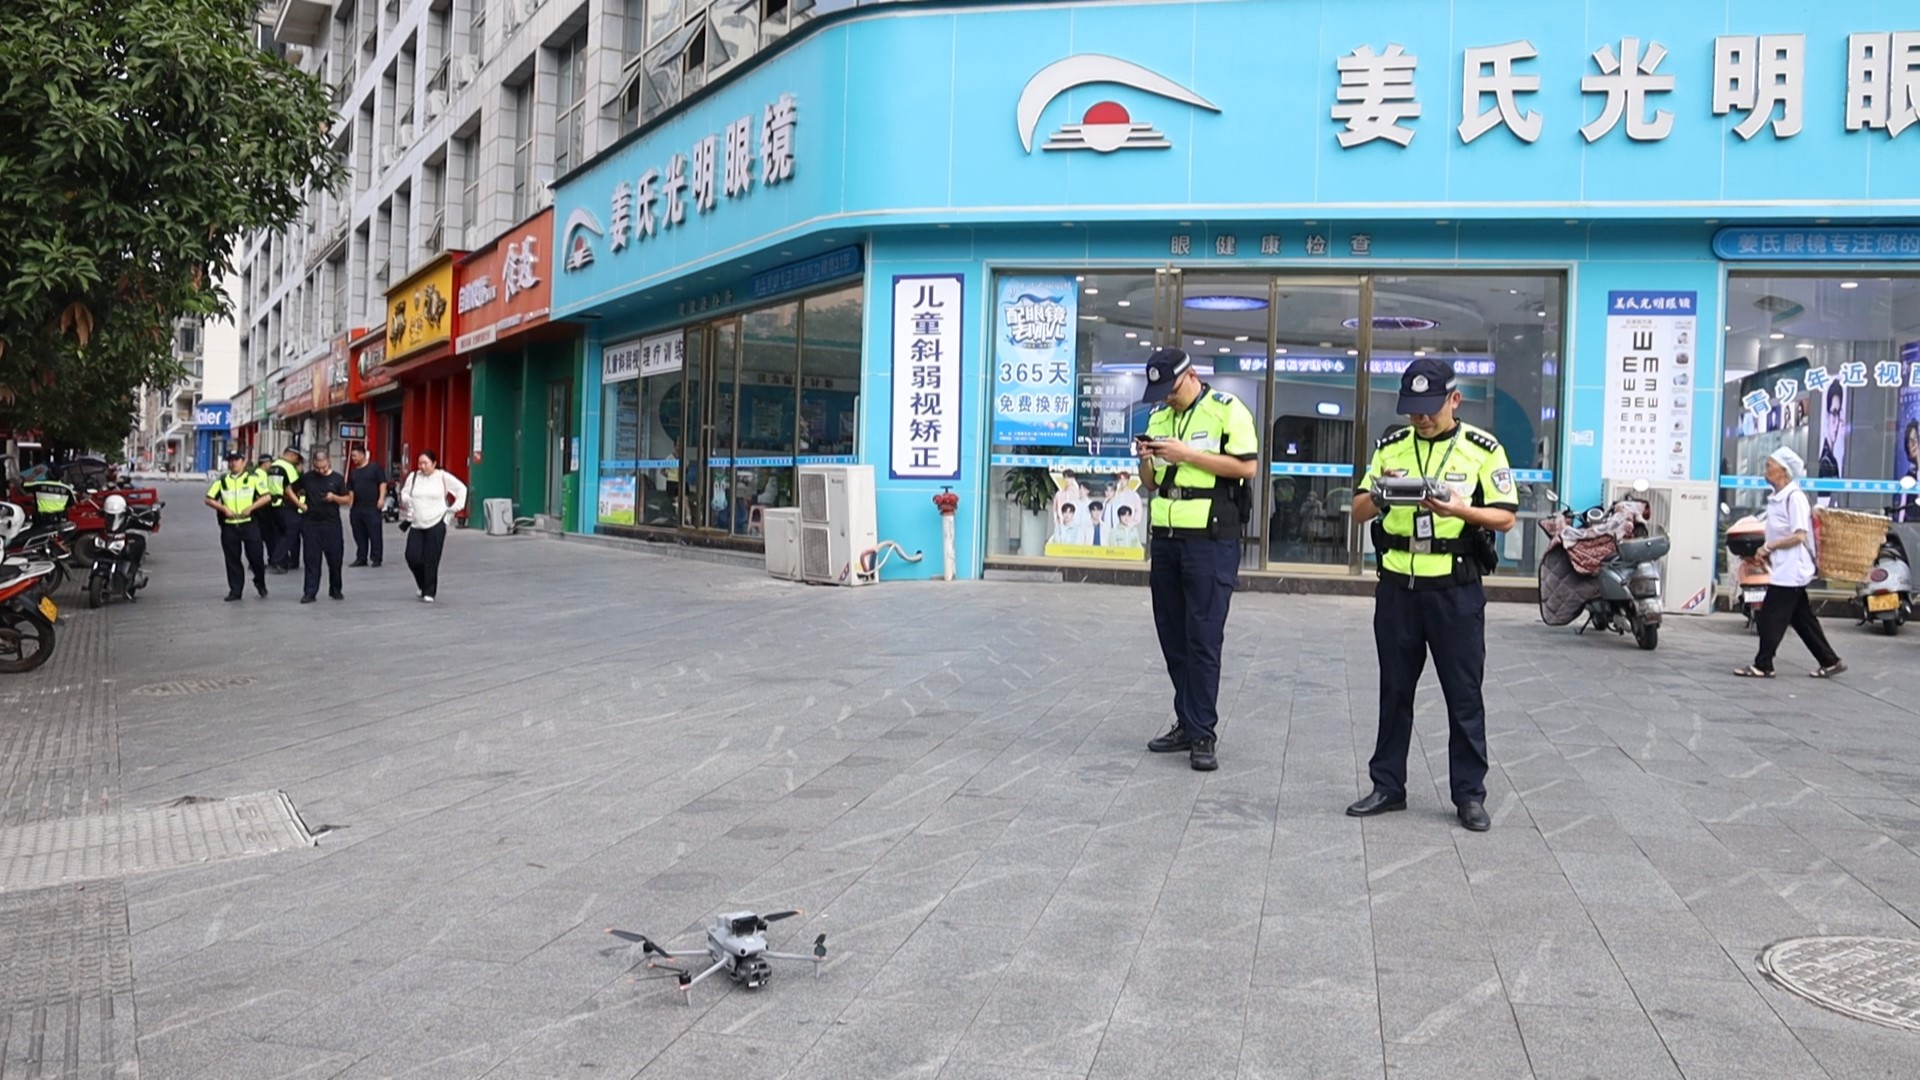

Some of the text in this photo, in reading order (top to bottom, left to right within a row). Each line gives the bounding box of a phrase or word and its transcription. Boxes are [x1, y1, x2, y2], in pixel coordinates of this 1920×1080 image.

[1331, 34, 1920, 149] 姜氏光明眼
[609, 93, 797, 253] 姜氏光明眼镜
[1170, 234, 1371, 255] 眼健康检查
[1738, 233, 1920, 255] 姜氏眼镜专注您的
[909, 284, 945, 469] 儿童斜弱视矫正
[1000, 361, 1070, 384] 365天
[999, 394, 1071, 414] 免费换新
